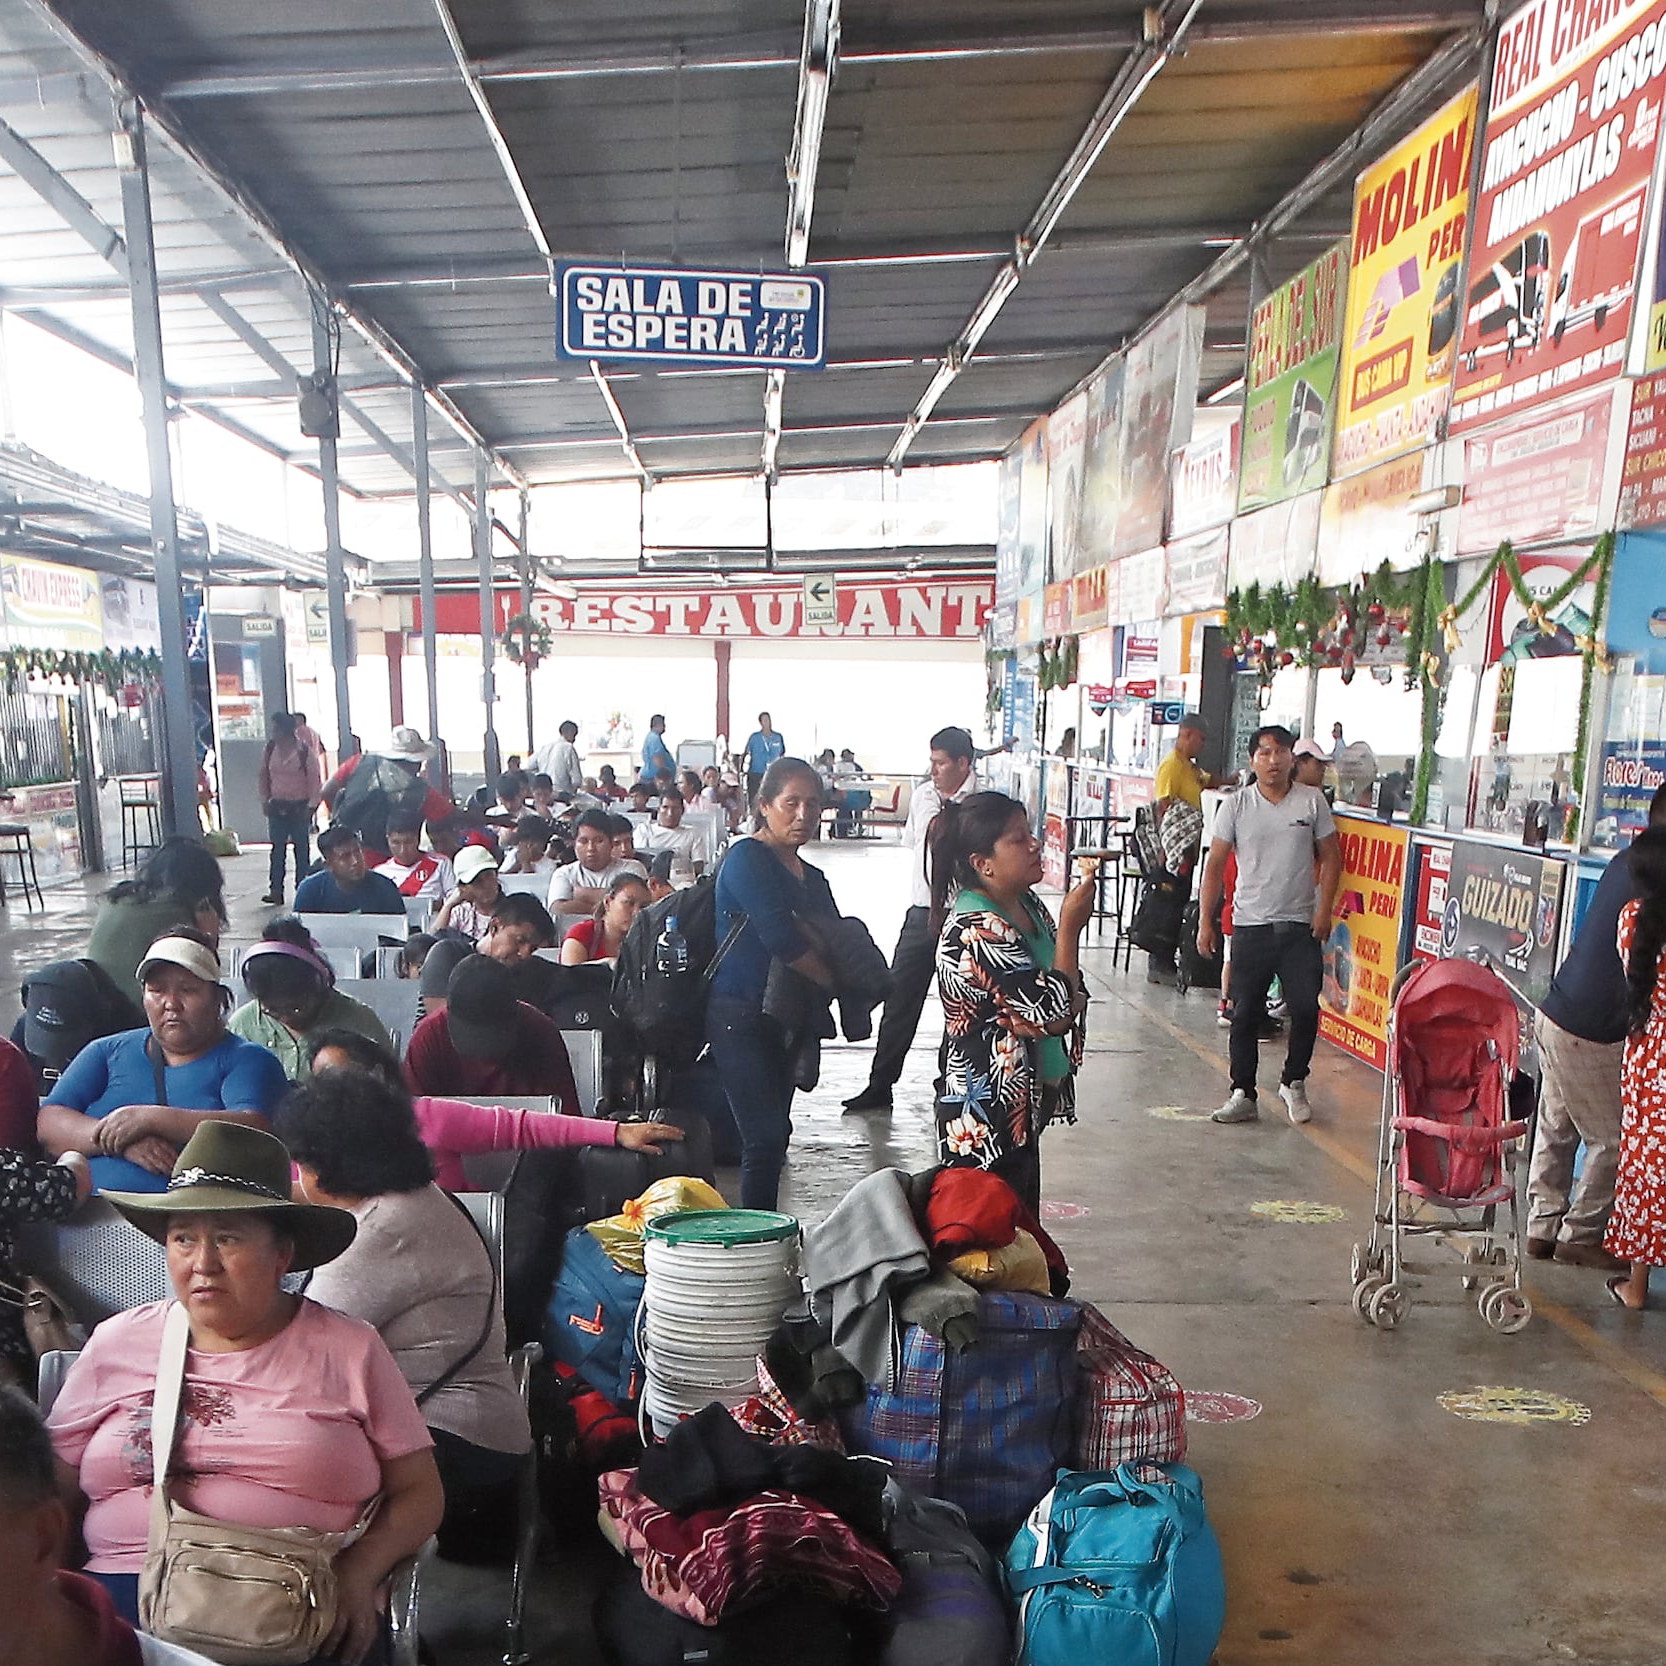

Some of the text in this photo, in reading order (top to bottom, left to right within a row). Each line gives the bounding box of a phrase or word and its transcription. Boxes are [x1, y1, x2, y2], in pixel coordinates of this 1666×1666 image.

[1481, 79, 1581, 194] AYACUCHO
[576, 276, 753, 317] SALA DE
[583, 312, 747, 352] ESPERA
[246, 621, 273, 632] SALIDA
[1369, 886, 1398, 921] PERÚ
